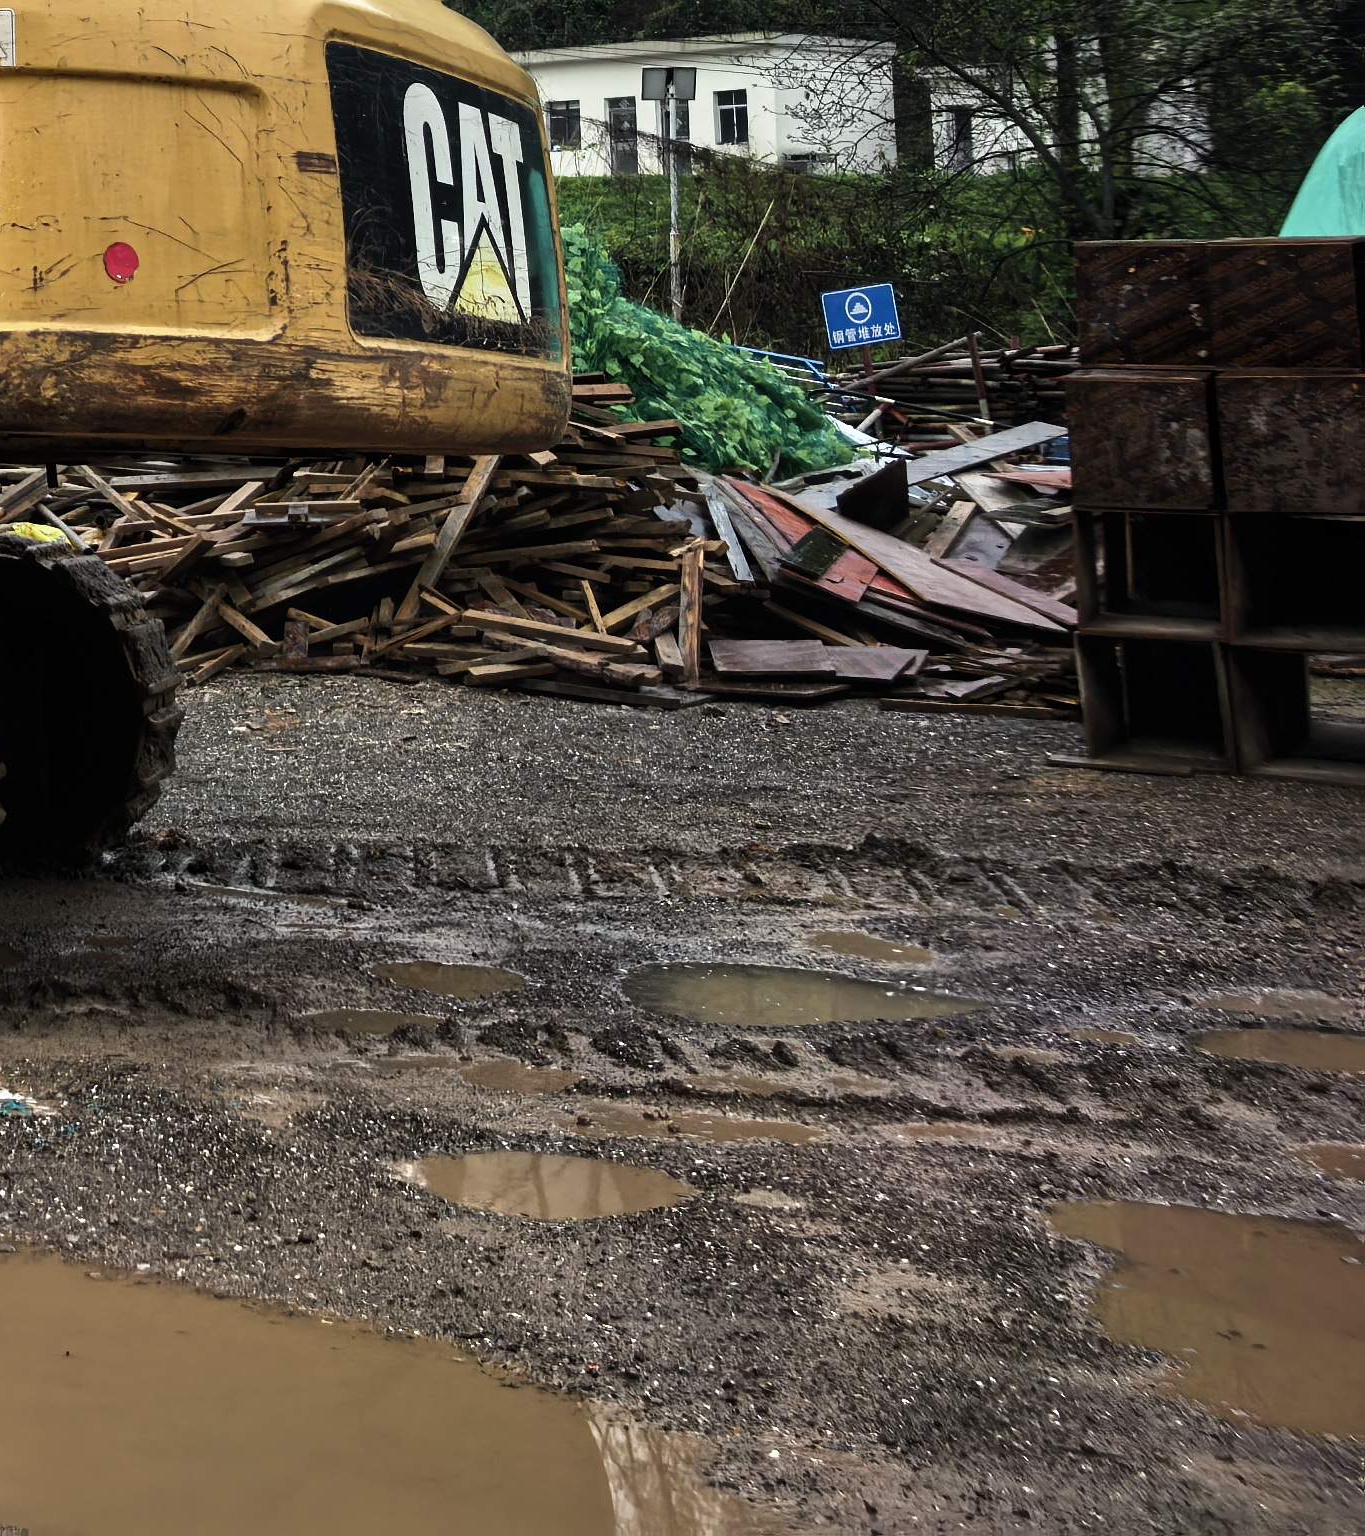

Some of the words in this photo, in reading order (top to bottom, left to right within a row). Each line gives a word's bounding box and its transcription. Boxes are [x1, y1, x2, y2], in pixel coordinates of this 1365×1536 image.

[403, 82, 532, 325] CAT
[832, 322, 896, 345] 钢管堆放处
